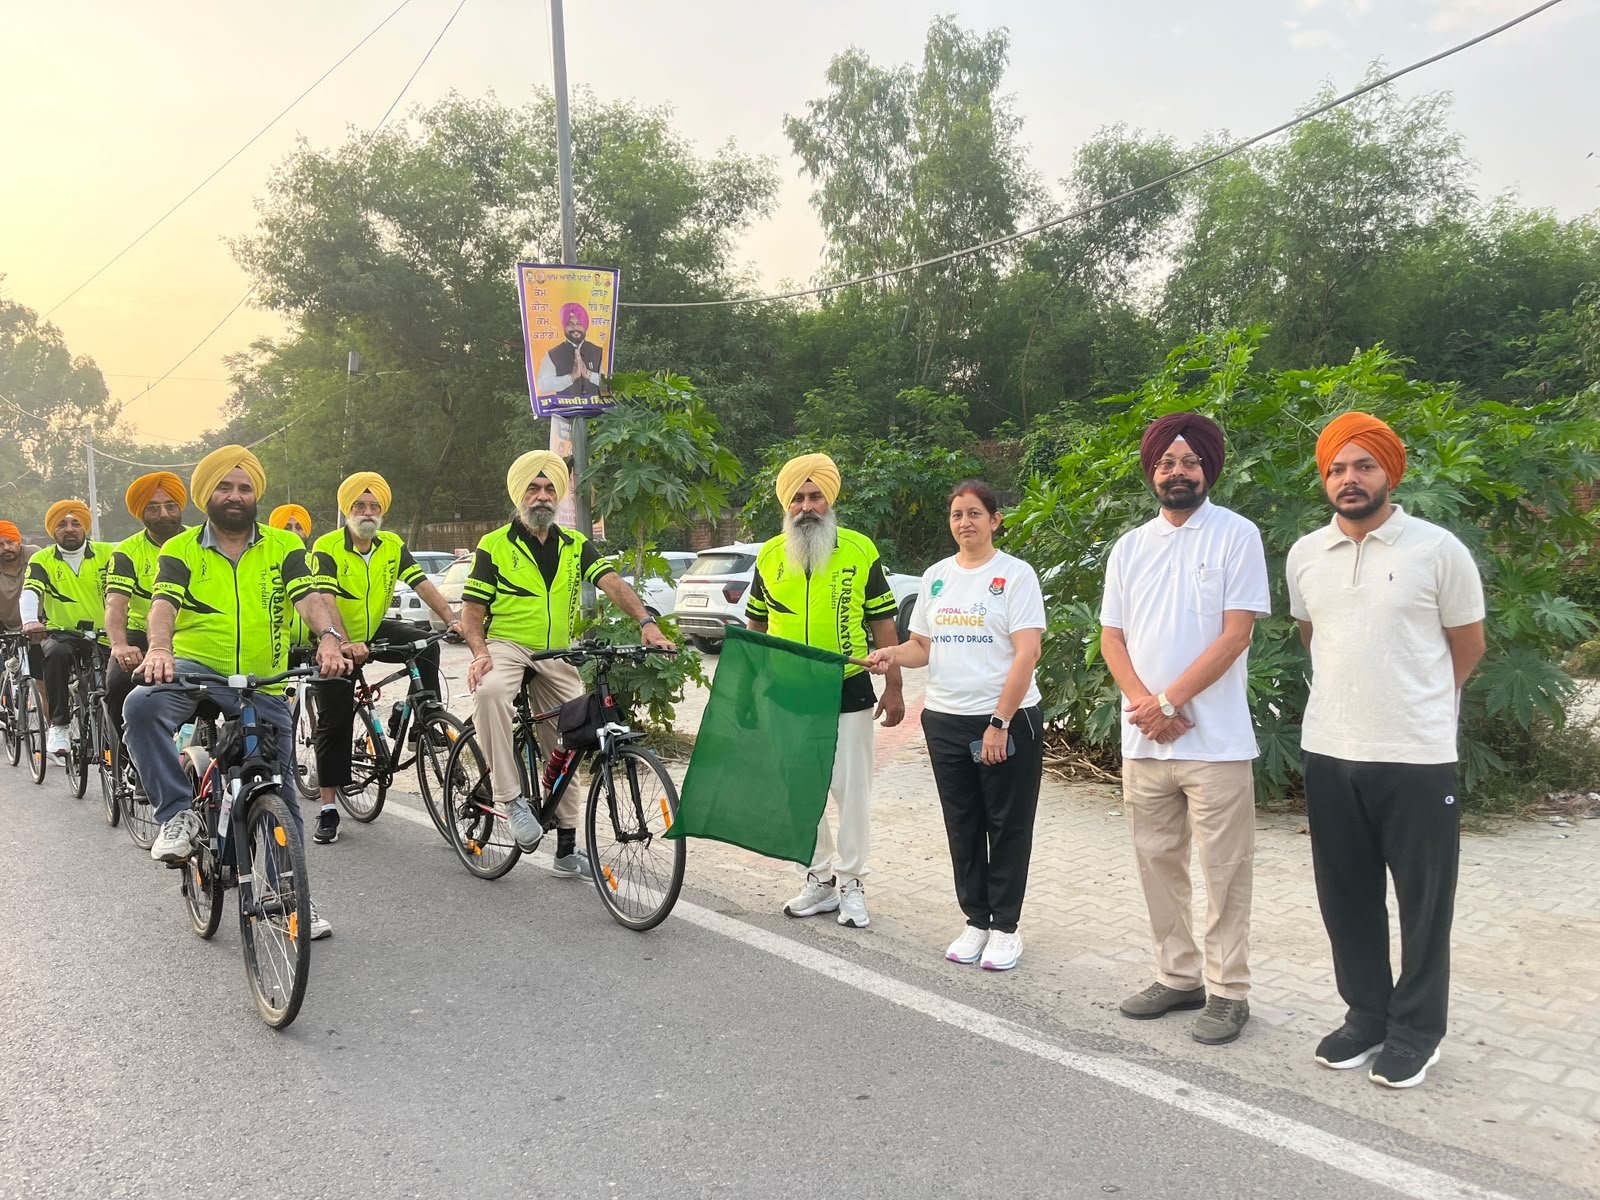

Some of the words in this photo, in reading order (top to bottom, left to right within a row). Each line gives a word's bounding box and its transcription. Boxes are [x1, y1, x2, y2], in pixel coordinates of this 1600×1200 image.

[840, 565, 857, 657] TURBANATOR
[935, 614, 985, 627] CHANGE
[931, 635, 941, 644] AY
[940, 635, 952, 643] NO
[953, 635, 965, 643] TO
[966, 635, 993, 643] DRUGS
